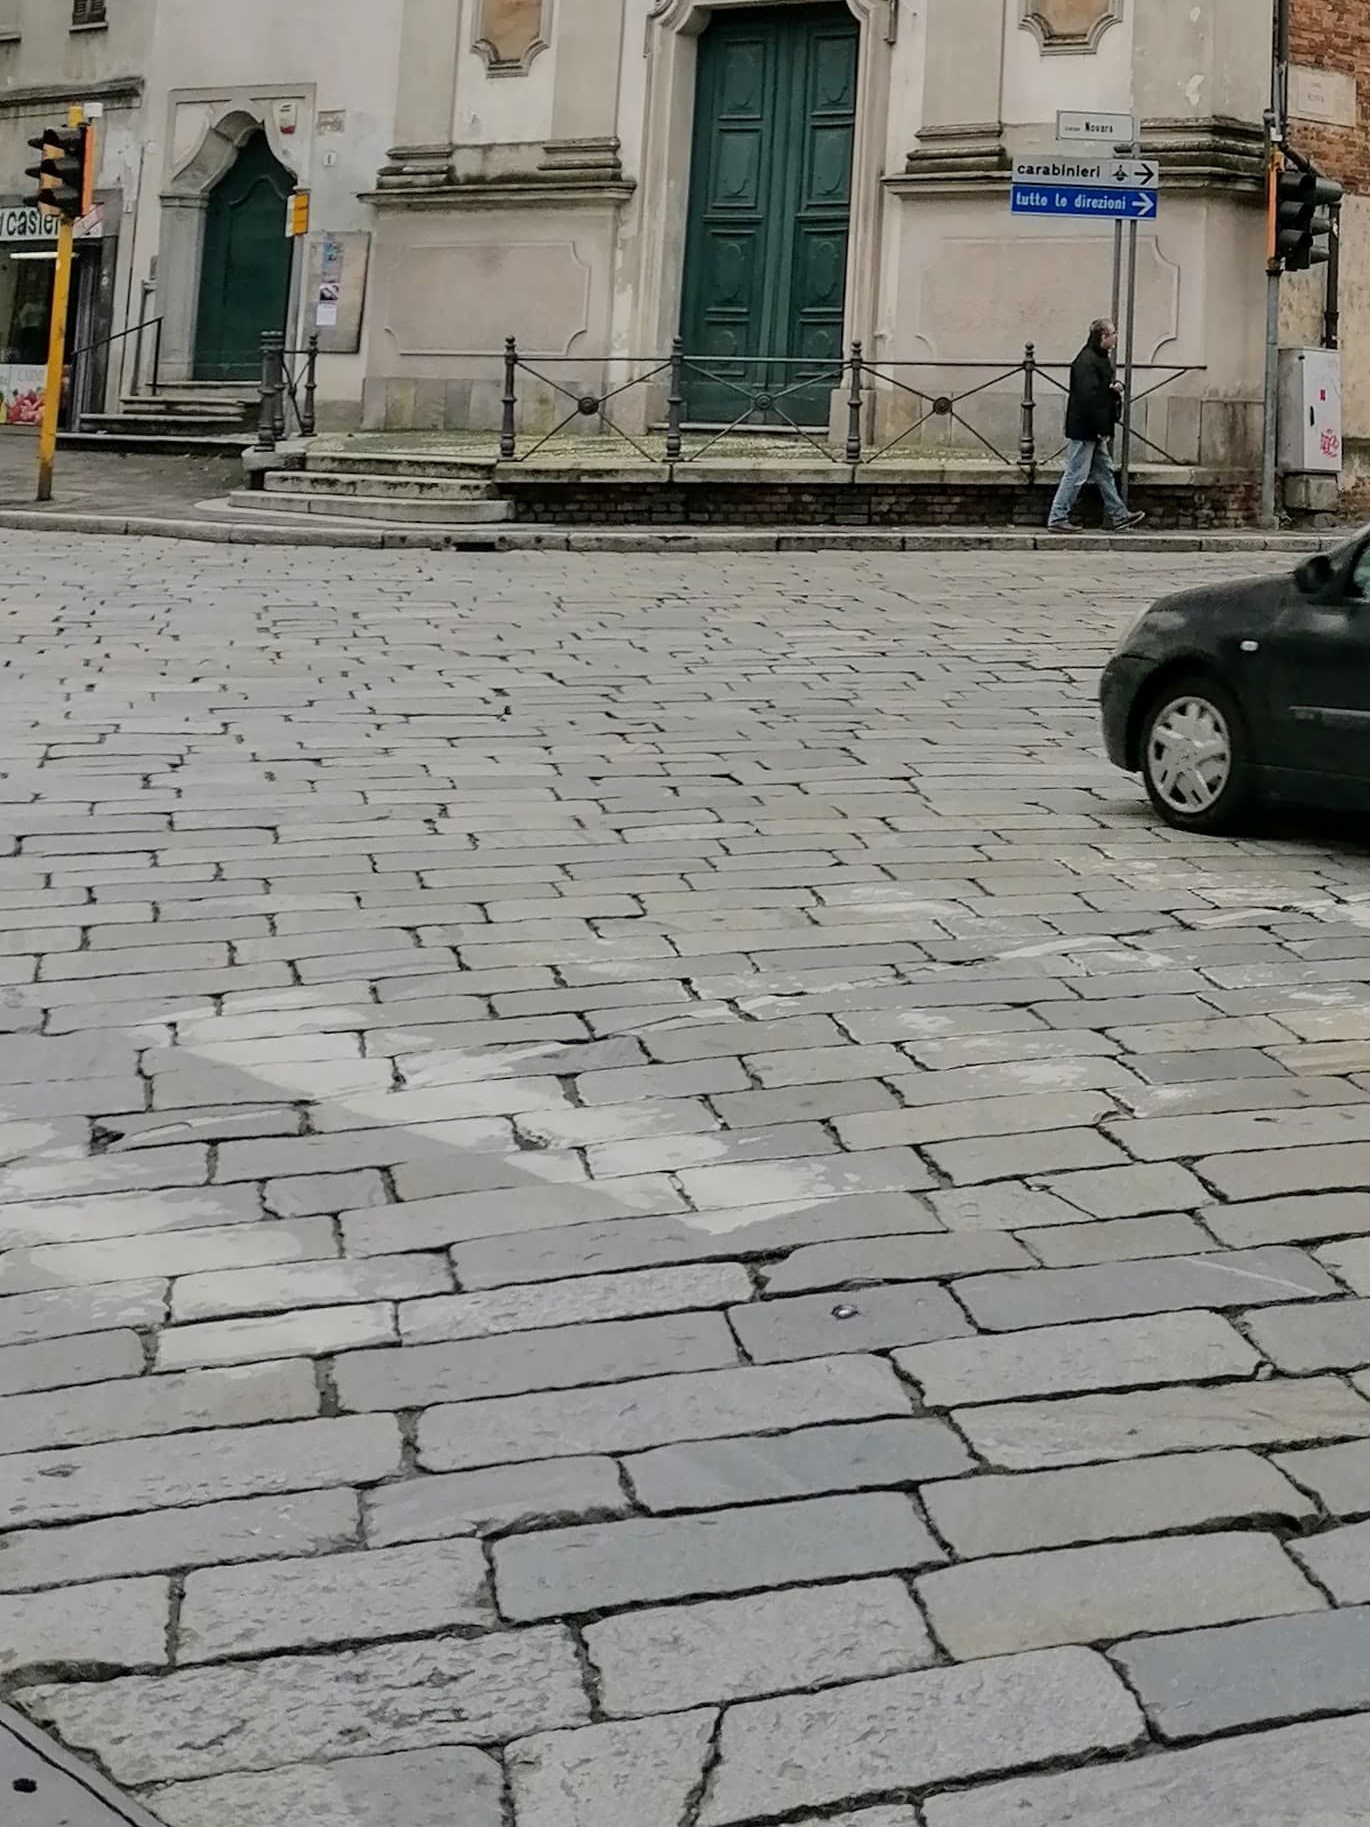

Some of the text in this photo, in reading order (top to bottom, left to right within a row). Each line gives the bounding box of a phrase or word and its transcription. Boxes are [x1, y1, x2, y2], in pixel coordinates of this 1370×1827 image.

[1017, 163, 1100, 178] carabinieri
[1016, 191, 1126, 210] tutte le direzioni
